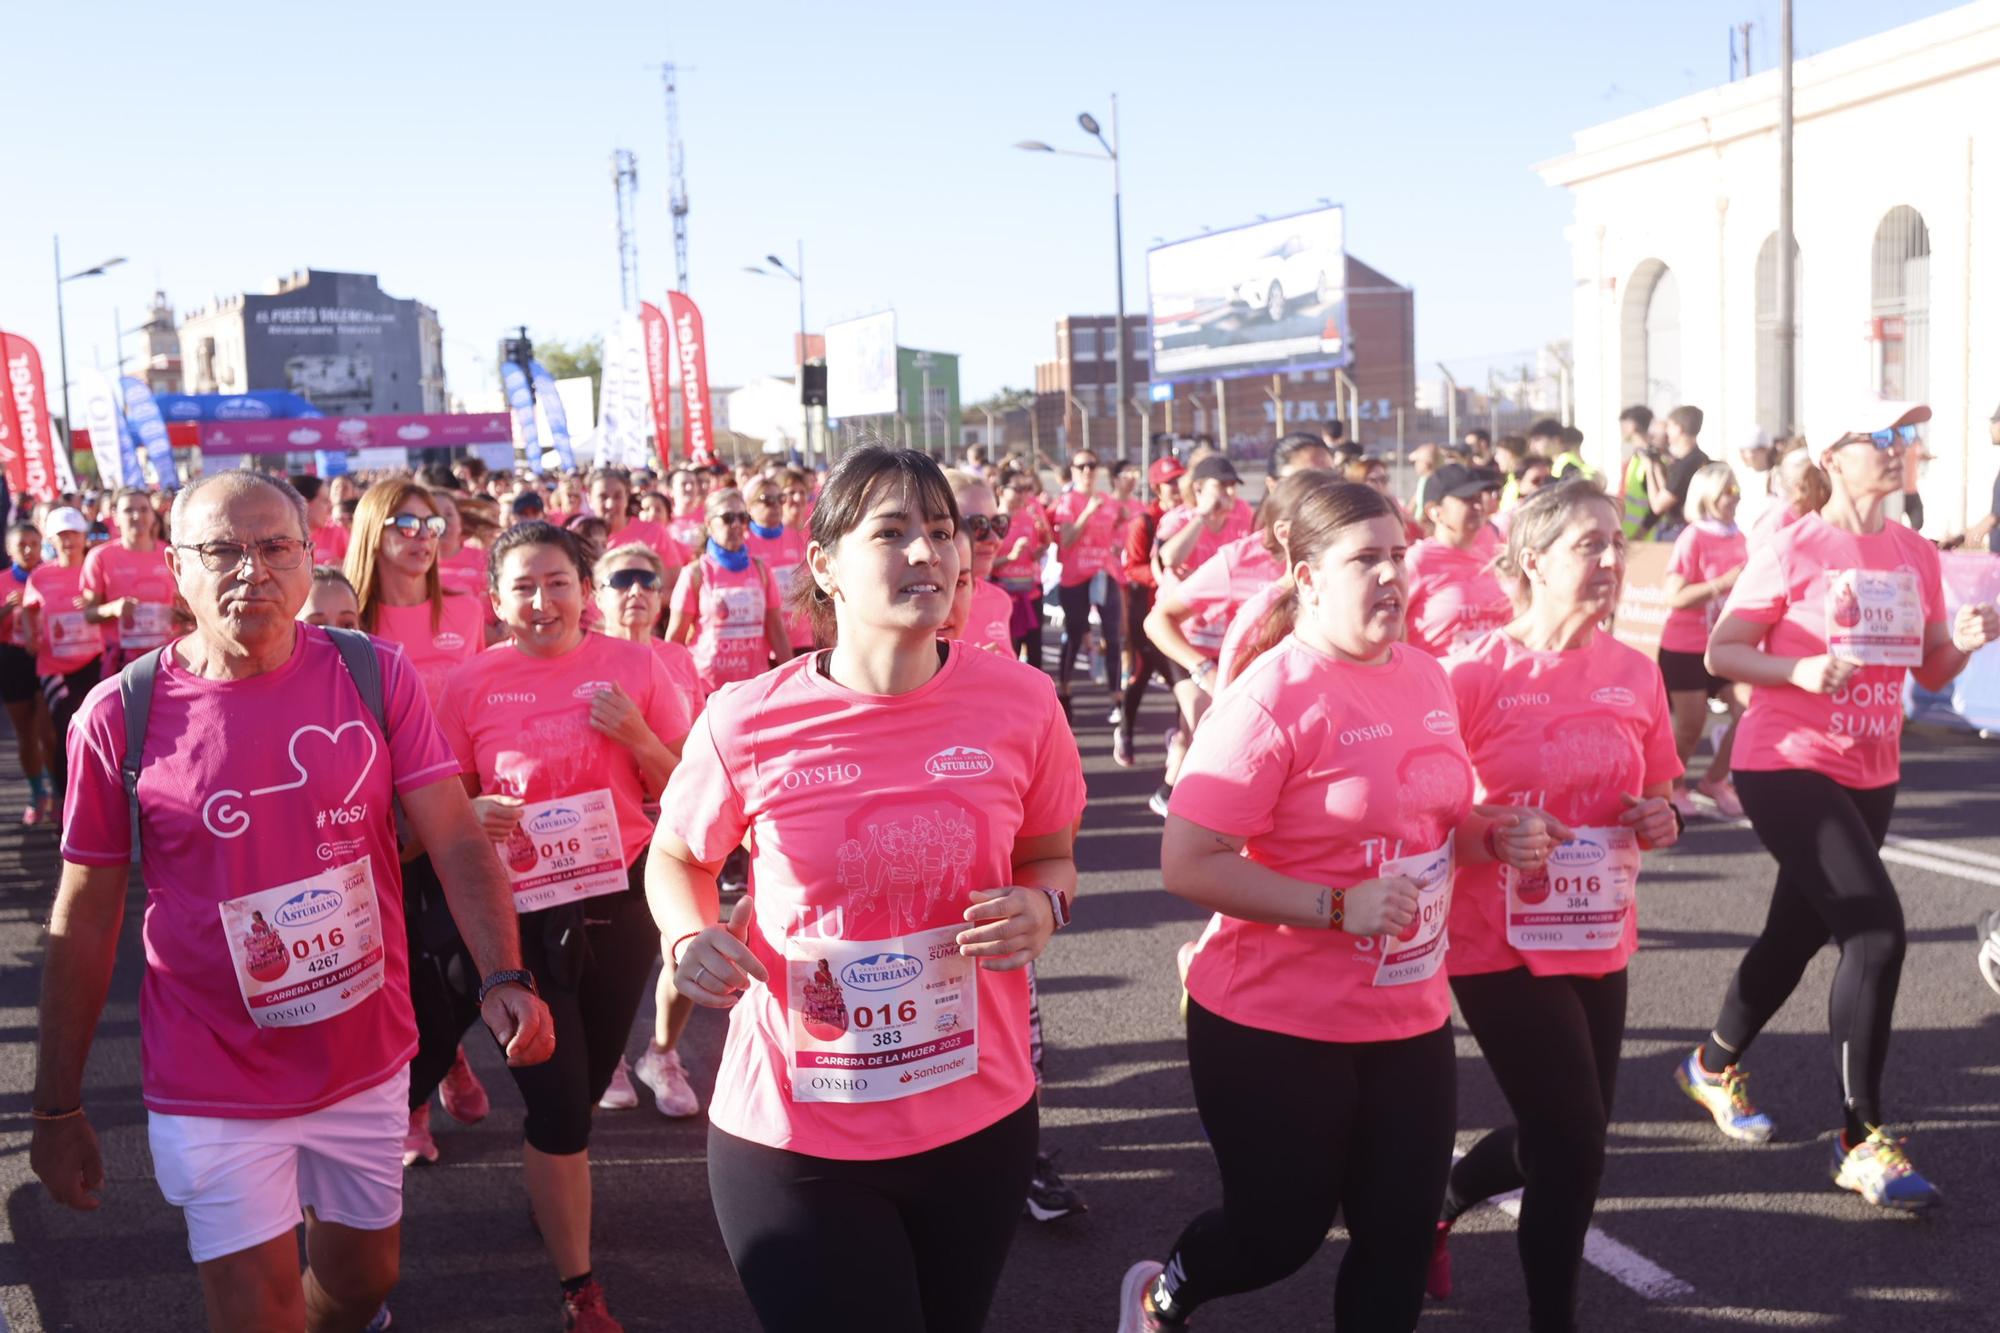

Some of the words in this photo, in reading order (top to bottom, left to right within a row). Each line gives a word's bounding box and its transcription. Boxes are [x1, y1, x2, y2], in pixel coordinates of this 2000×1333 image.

[1864, 607, 1893, 622] 016
[487, 692, 536, 704] OYSHO
[1497, 692, 1550, 711] OYSHO
[1340, 723, 1393, 746] OYSHO
[931, 759, 989, 773] ASTURIANA
[784, 763, 861, 790] OYSHO
[534, 816, 577, 831] ASTURIANA
[540, 838, 580, 858] 016
[1359, 837, 1403, 868] TU
[1552, 848, 1601, 861] ASTURIANA
[551, 856, 576, 870] 3635
[1554, 876, 1600, 893] 016
[520, 890, 555, 905] OYSHO
[1567, 898, 1589, 908] 384
[282, 898, 339, 923] ASTURIANA
[1523, 915, 1561, 923] CARRERA
[1576, 914, 1586, 922] LA
[292, 927, 345, 960] 016
[1520, 932, 1563, 943] OYSHO
[308, 953, 339, 973] 4267
[1388, 963, 1425, 979] OYSHO
[265, 984, 310, 1004] CARRERA
[312, 979, 325, 990] DE
[326, 975, 338, 986] LA
[338, 962, 362, 982] MUJER
[848, 966, 917, 984] ASTURIANA
[266, 1001, 316, 1022] OYSHO
[853, 1000, 917, 1028] 016
[873, 1031, 902, 1047] 383
[815, 1055, 865, 1066] CARRERA
[868, 1057, 883, 1066] DE
[885, 1054, 898, 1063] LA
[901, 1045, 935, 1061] MUJER
[939, 1037, 961, 1050] 2023
[811, 1077, 868, 1091] OYSHO
[913, 1057, 966, 1080] Santander
